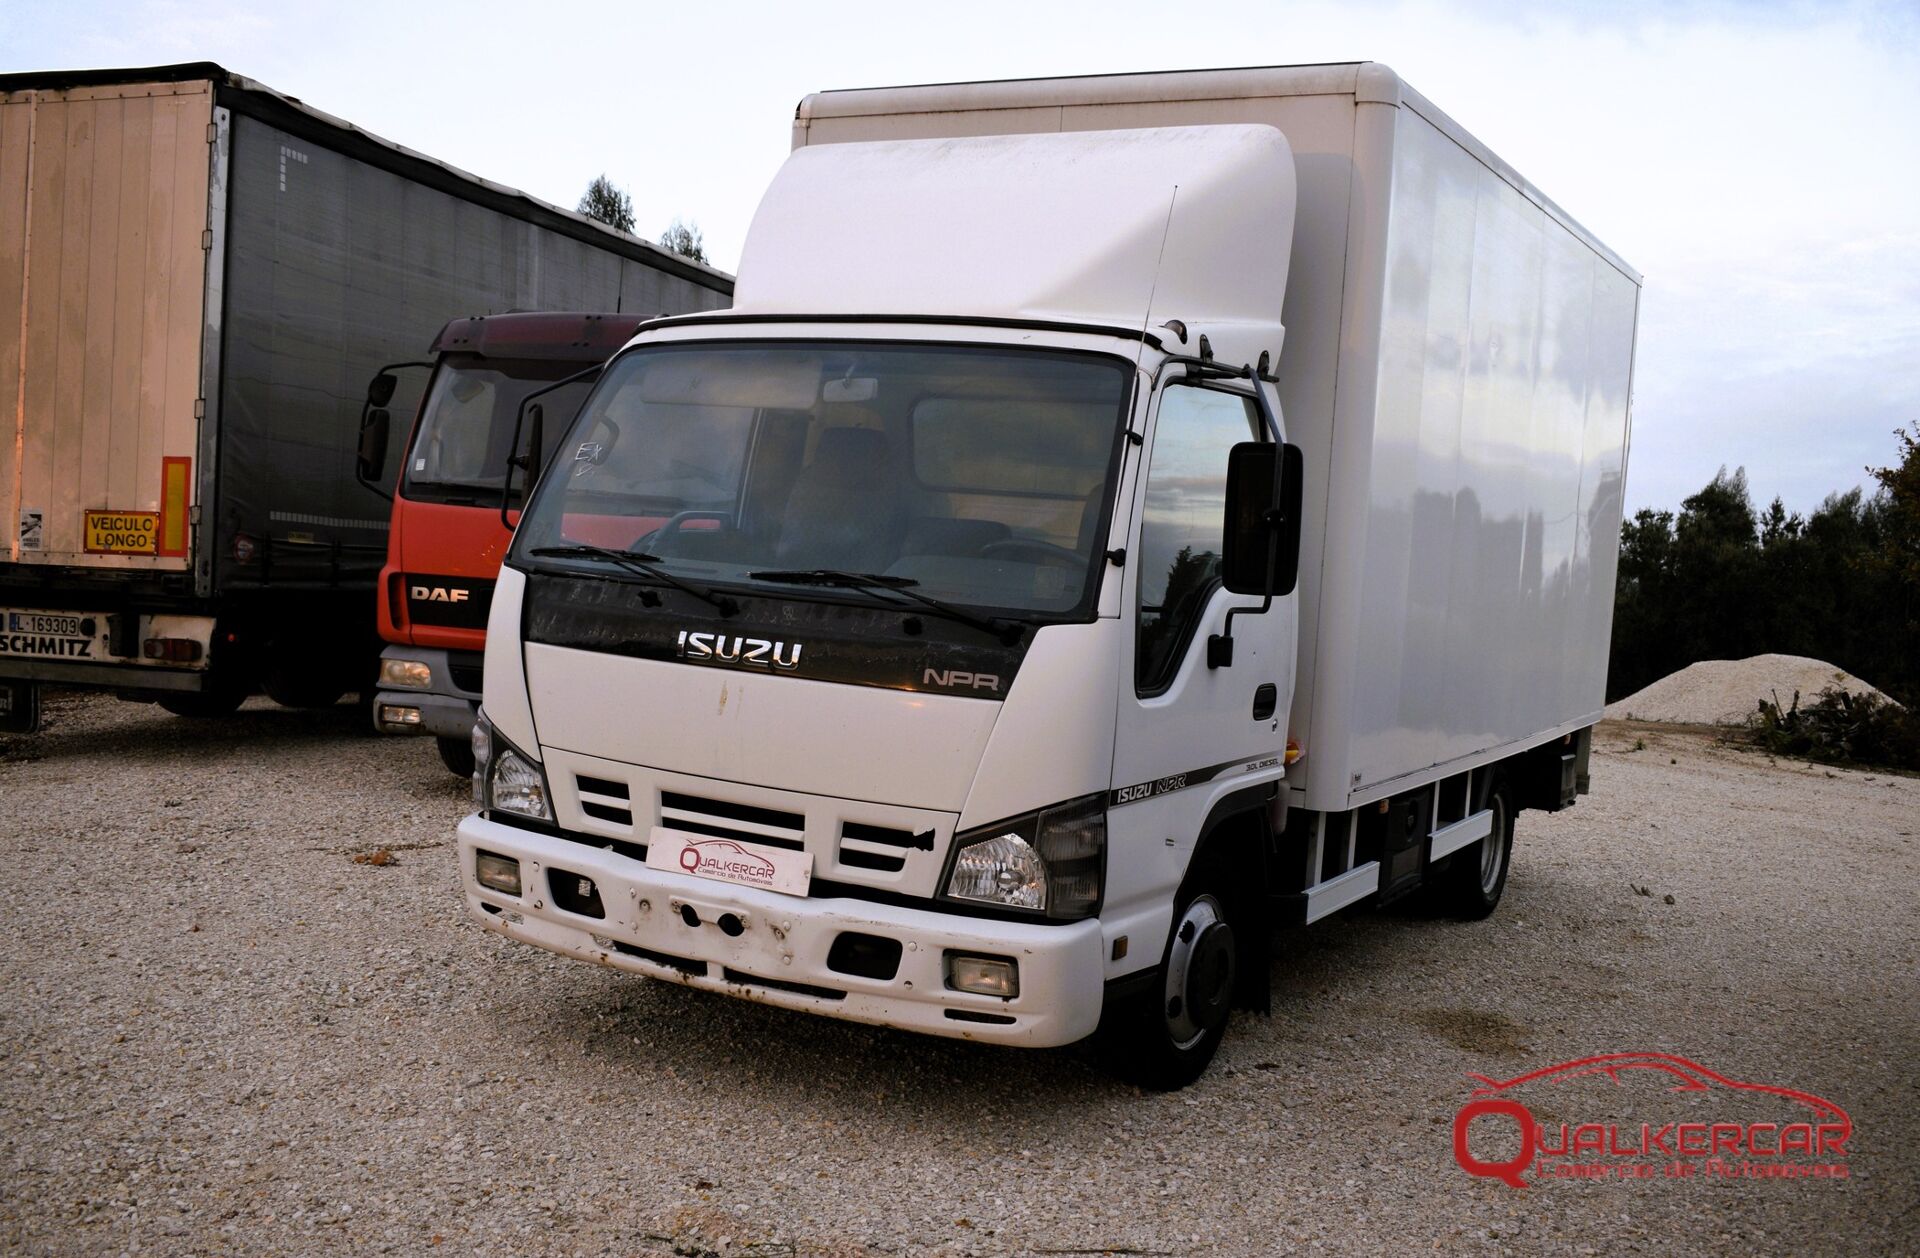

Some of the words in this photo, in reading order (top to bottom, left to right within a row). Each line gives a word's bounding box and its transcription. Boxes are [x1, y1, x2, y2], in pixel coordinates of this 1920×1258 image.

[96, 533, 147, 547] LONGO
[411, 586, 469, 602] DAF
[0, 635, 91, 657] SCHMITZ
[677, 630, 802, 670] ISUZU
[923, 668, 999, 691] NPR
[1117, 783, 1152, 804] ISUZU
[1156, 773, 1187, 794] NPR
[680, 847, 775, 879] QUALKERCAR
